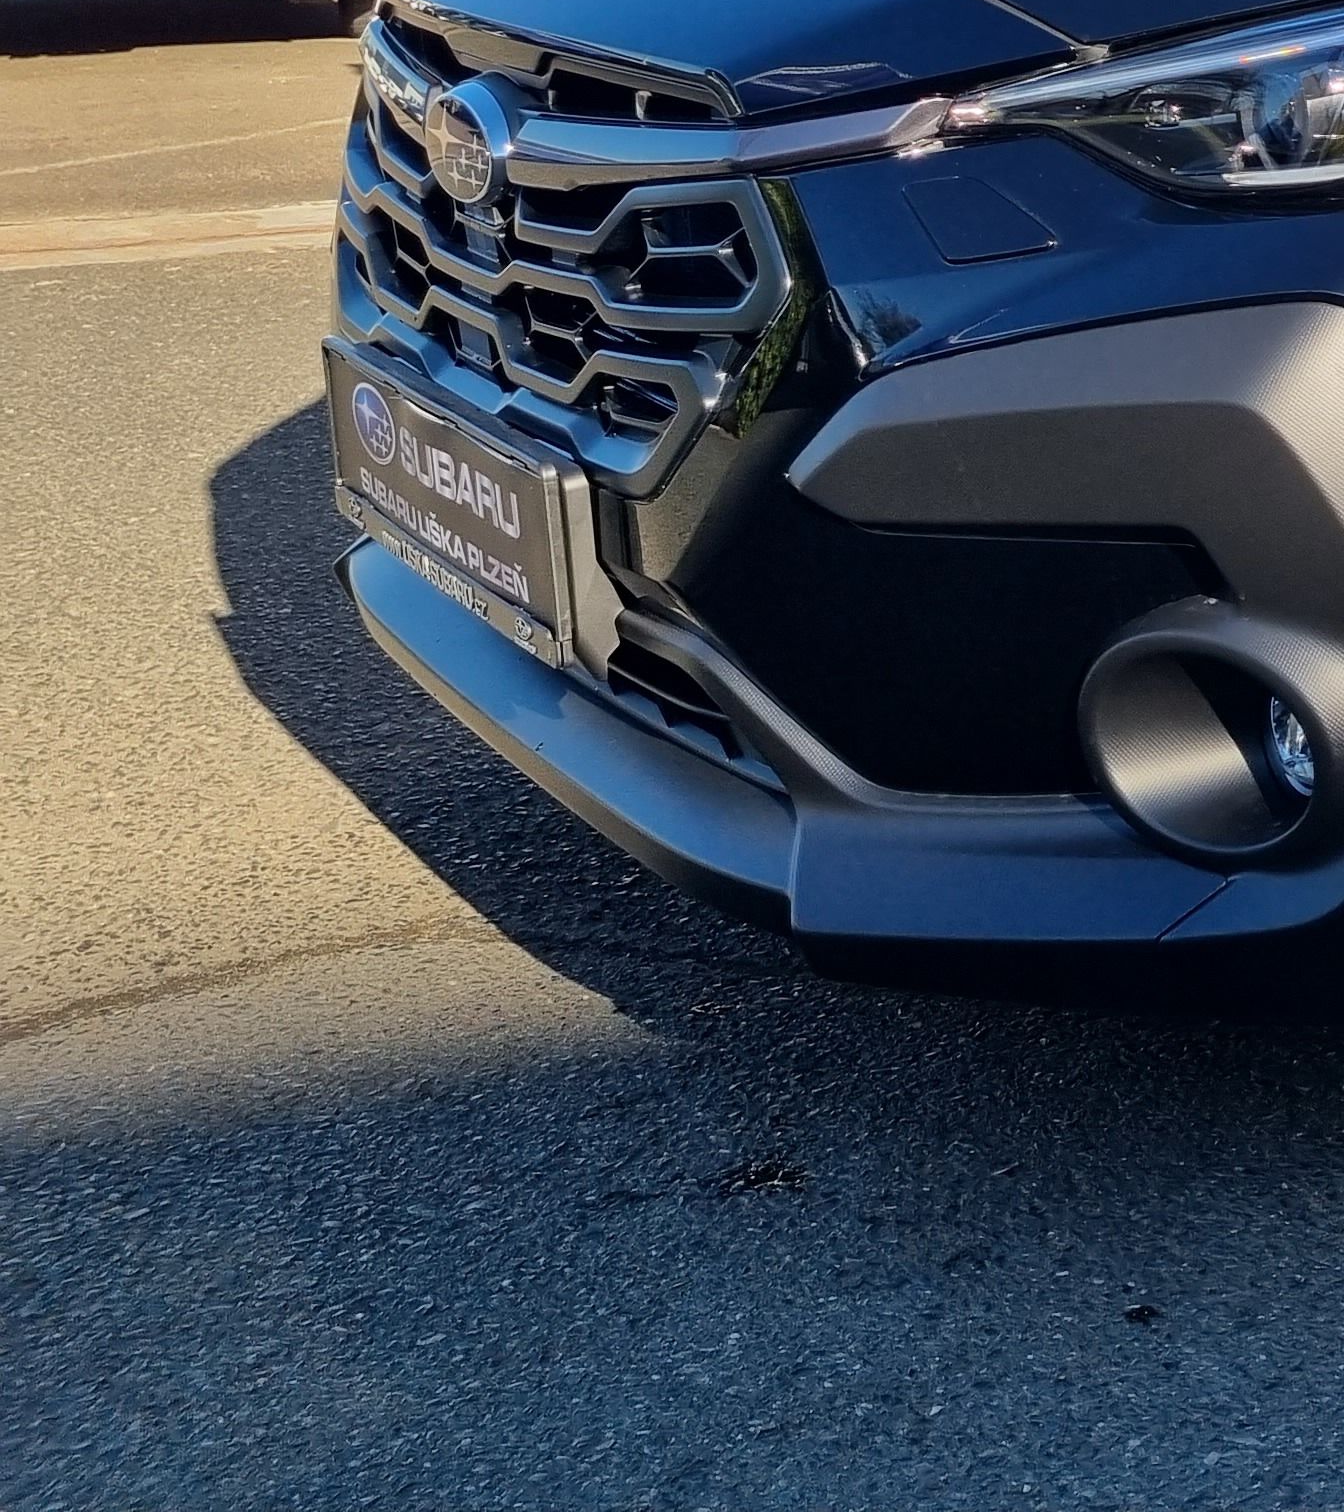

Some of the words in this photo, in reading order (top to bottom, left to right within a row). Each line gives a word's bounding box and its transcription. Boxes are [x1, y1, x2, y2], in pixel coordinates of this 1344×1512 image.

[360, 466, 417, 531] SUBARU
[416, 511, 468, 567] LIŠKA
[466, 542, 531, 604] PLZEŇ
[400, 426, 521, 539] SUBARU
